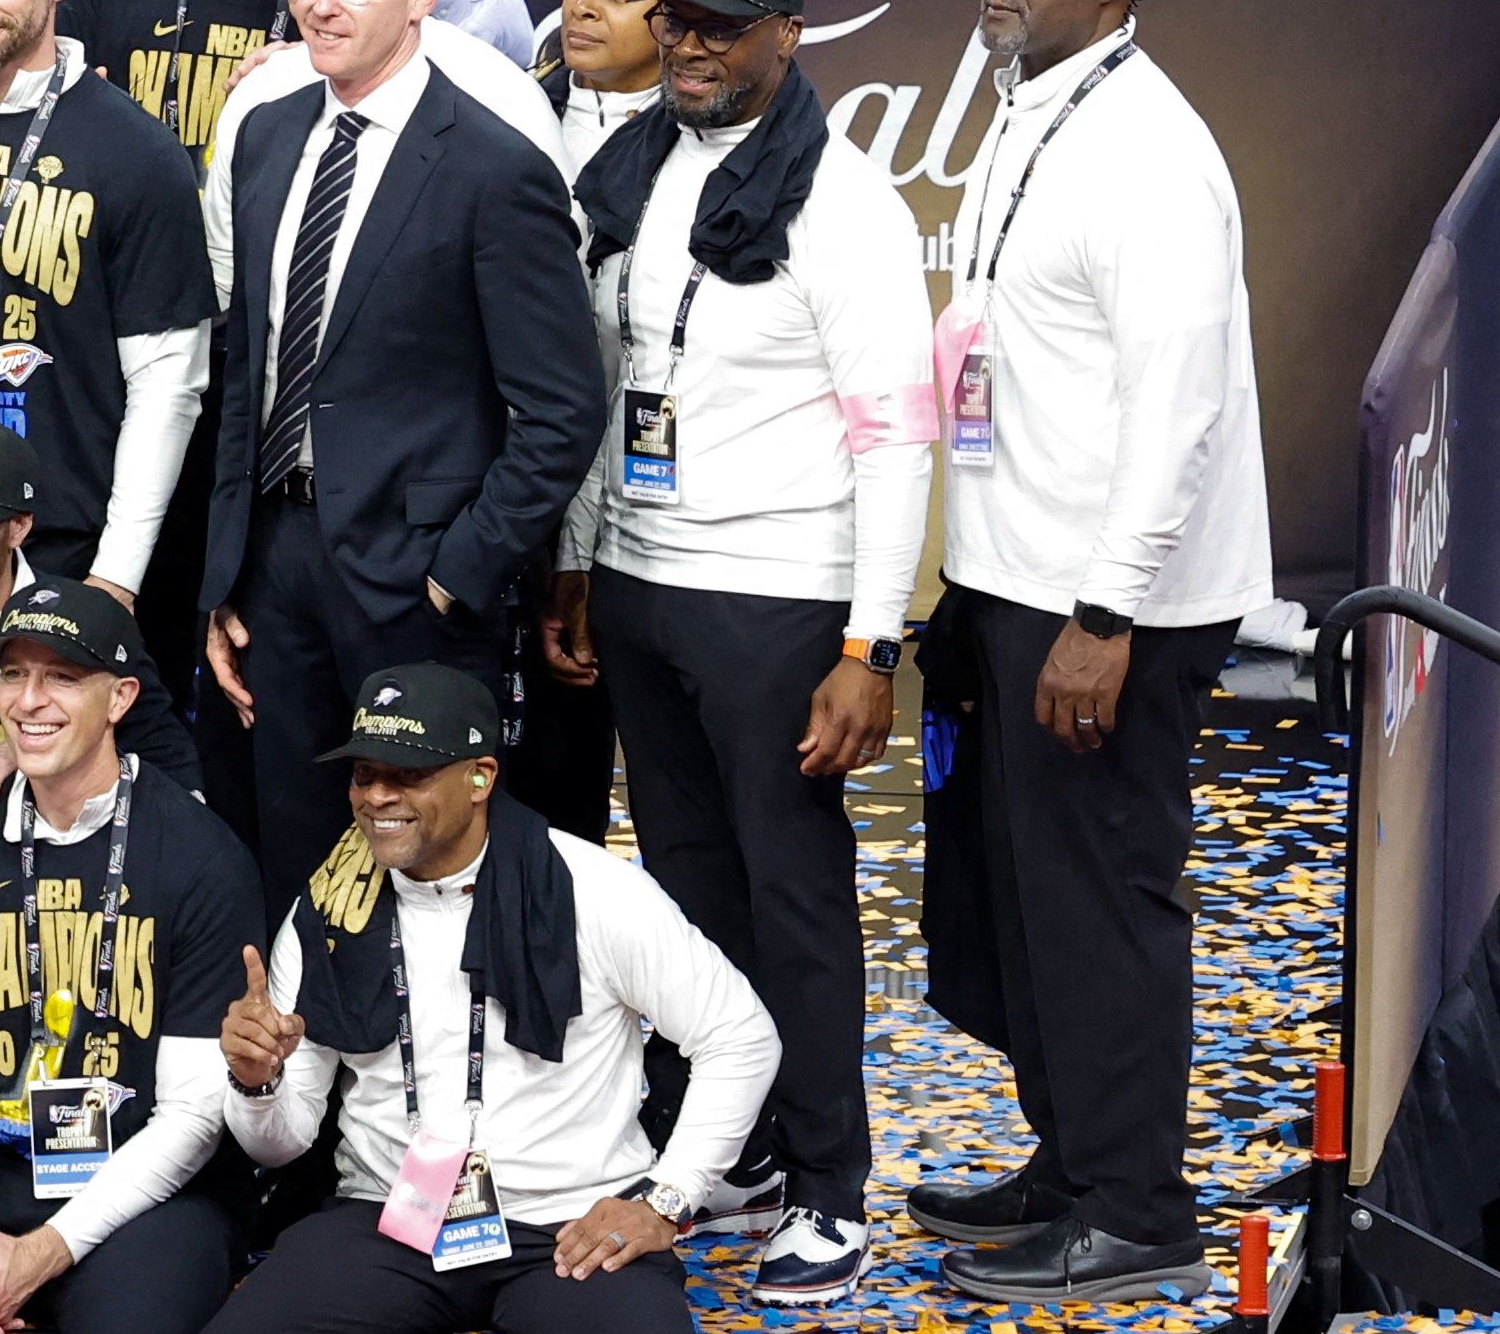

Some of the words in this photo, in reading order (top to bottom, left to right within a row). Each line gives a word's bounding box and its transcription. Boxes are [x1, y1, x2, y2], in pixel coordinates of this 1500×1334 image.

[205, 25, 266, 56] NBA
[3, 295, 36, 340] 25
[633, 462, 660, 476] GAME
[3, 607, 80, 635] Champions
[354, 707, 425, 735] Champions
[45, 1136, 97, 1150] PRESENTATION
[36, 1161, 68, 1174] STAGE
[443, 1228, 480, 1244] GAME
